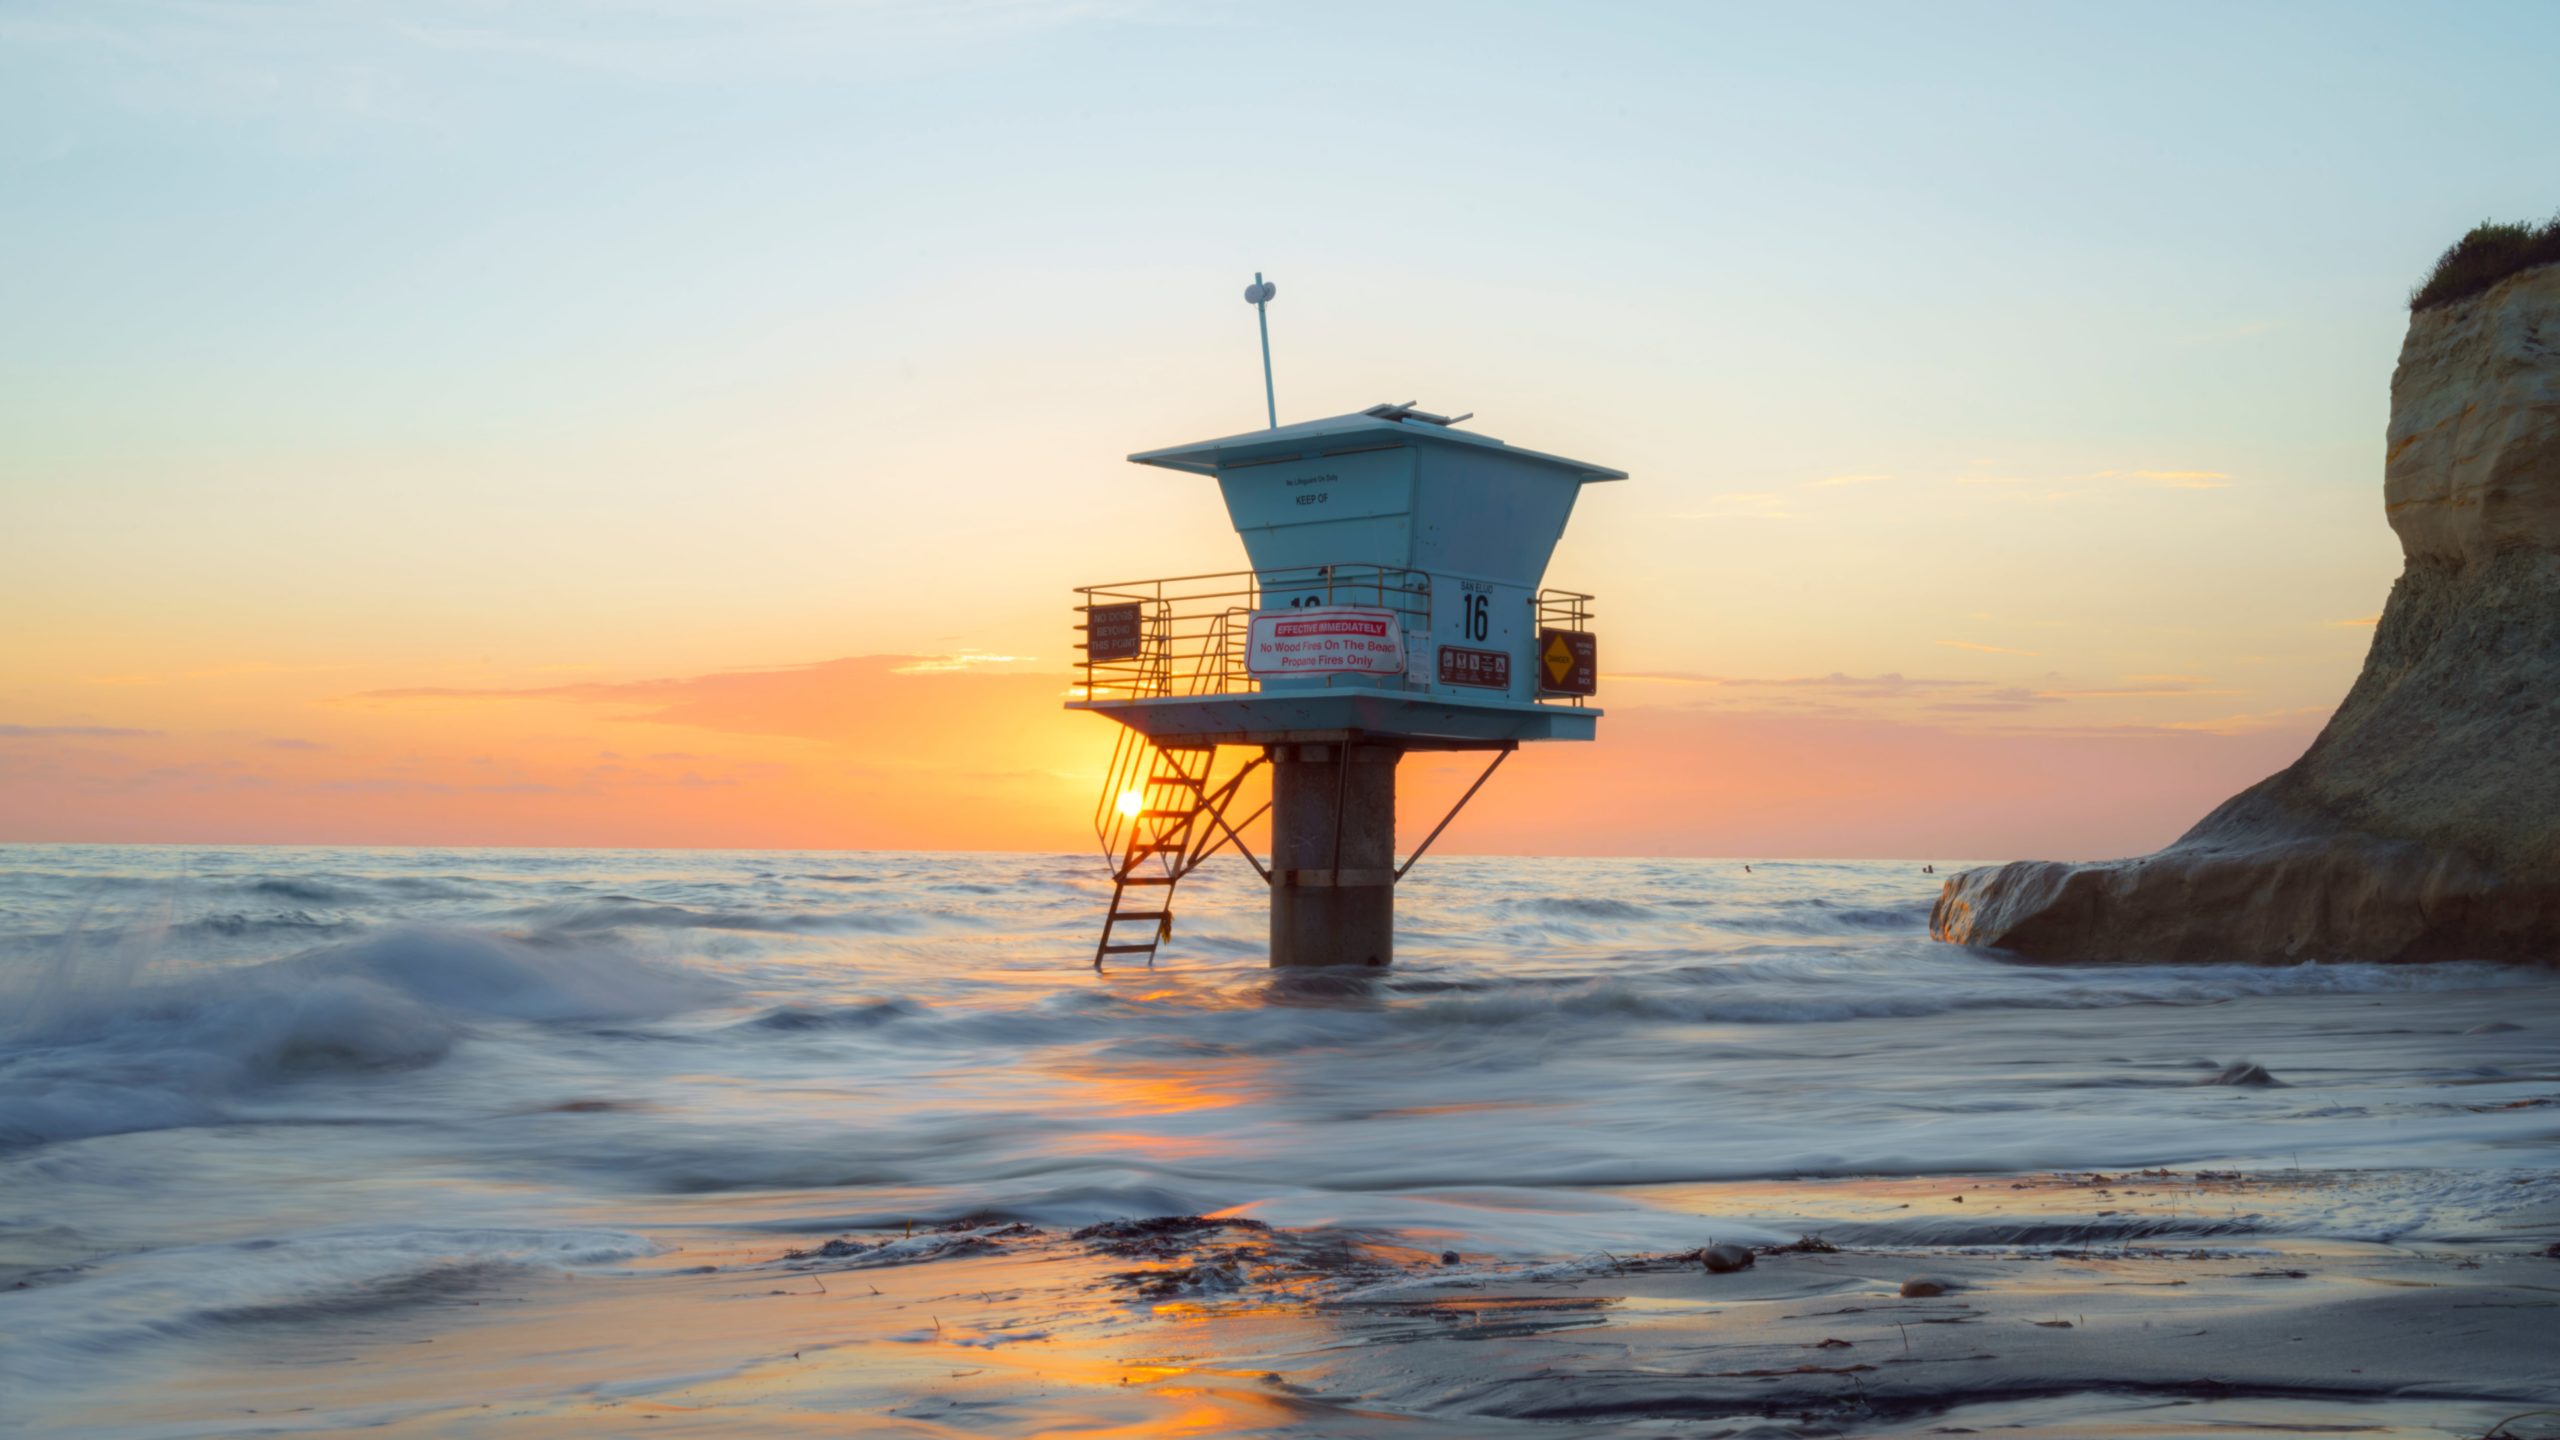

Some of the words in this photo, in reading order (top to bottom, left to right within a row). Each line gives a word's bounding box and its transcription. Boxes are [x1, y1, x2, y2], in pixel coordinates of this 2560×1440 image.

[1296, 494, 1315, 505] KEEP
[1461, 581, 1474, 592] SAN
[1094, 613, 1107, 624] NO
[1464, 593, 1489, 642] 16
[1096, 625, 1131, 637] BEYOND
[1277, 623, 1318, 634] EFFECTIVE
[1318, 621, 1383, 633] IMMEDIATELY
[1092, 640, 1110, 651] THIS
[1112, 637, 1136, 649] POINT
[1260, 642, 1272, 653] No
[1274, 641, 1300, 652] Wood
[1302, 641, 1322, 650] Fires
[1324, 639, 1340, 650] On
[1343, 639, 1364, 650] The
[1367, 640, 1397, 653] Beach
[1281, 656, 1316, 667] Propane
[1318, 655, 1344, 665] Fires
[1347, 654, 1373, 668] Only
